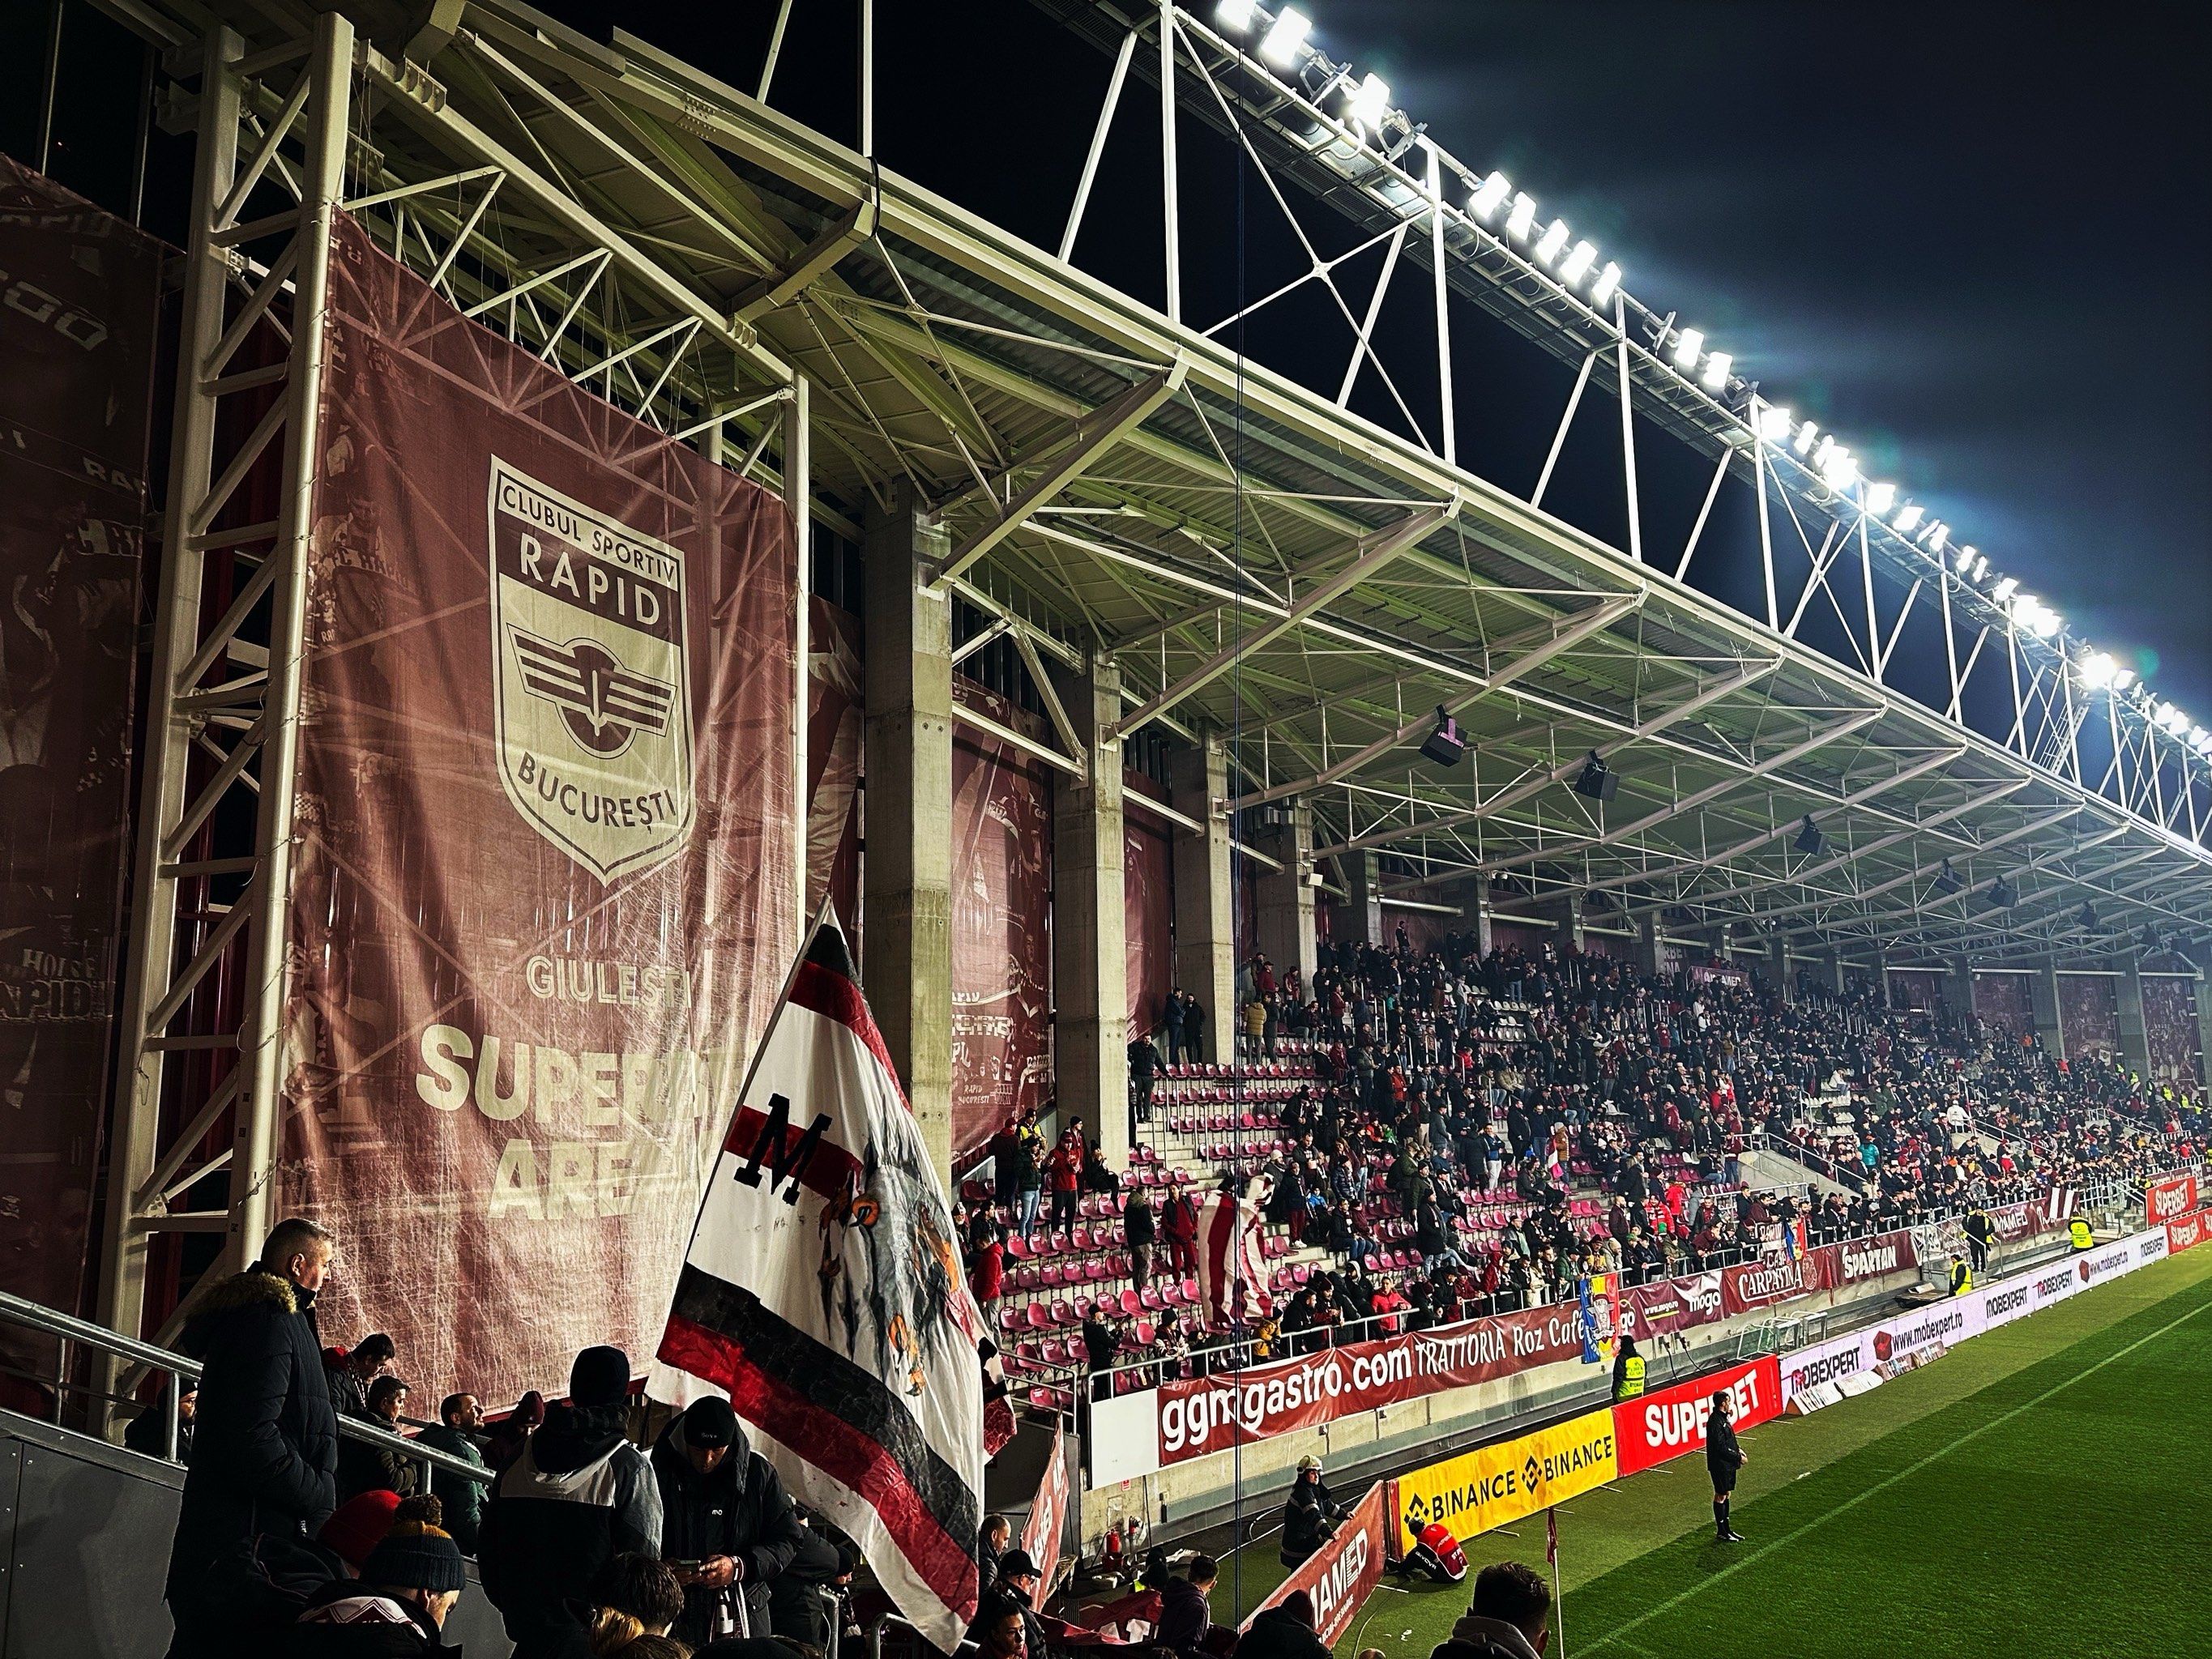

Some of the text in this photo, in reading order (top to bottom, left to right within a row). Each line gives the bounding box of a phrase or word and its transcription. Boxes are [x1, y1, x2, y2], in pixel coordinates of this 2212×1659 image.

[502, 484, 675, 582] CLUBUL SPORTIV
[520, 532, 660, 625] RAPID
[517, 751, 677, 834] BUCUREȘTI
[732, 1091, 833, 1208] M
[2155, 1180, 2189, 1217] SUPERBET
[1843, 1245, 1898, 1279] SPARTAN
[1620, 1311, 1636, 1335] go
[1689, 1291, 1722, 1316] mogo
[1986, 1286, 2027, 1319] MOBEXPERT
[1892, 1311, 1963, 1353] www.mobexpert.ro
[1161, 1346, 1412, 1452] ggmgastro.com
[1415, 1326, 1507, 1377] TRATTORIA
[1514, 1326, 1545, 1357] Roz
[1548, 1308, 1586, 1346] Café
[1791, 1346, 1860, 1395] MOBEXPERT
[1432, 1435, 1612, 1523] BINANCE BINANCE
